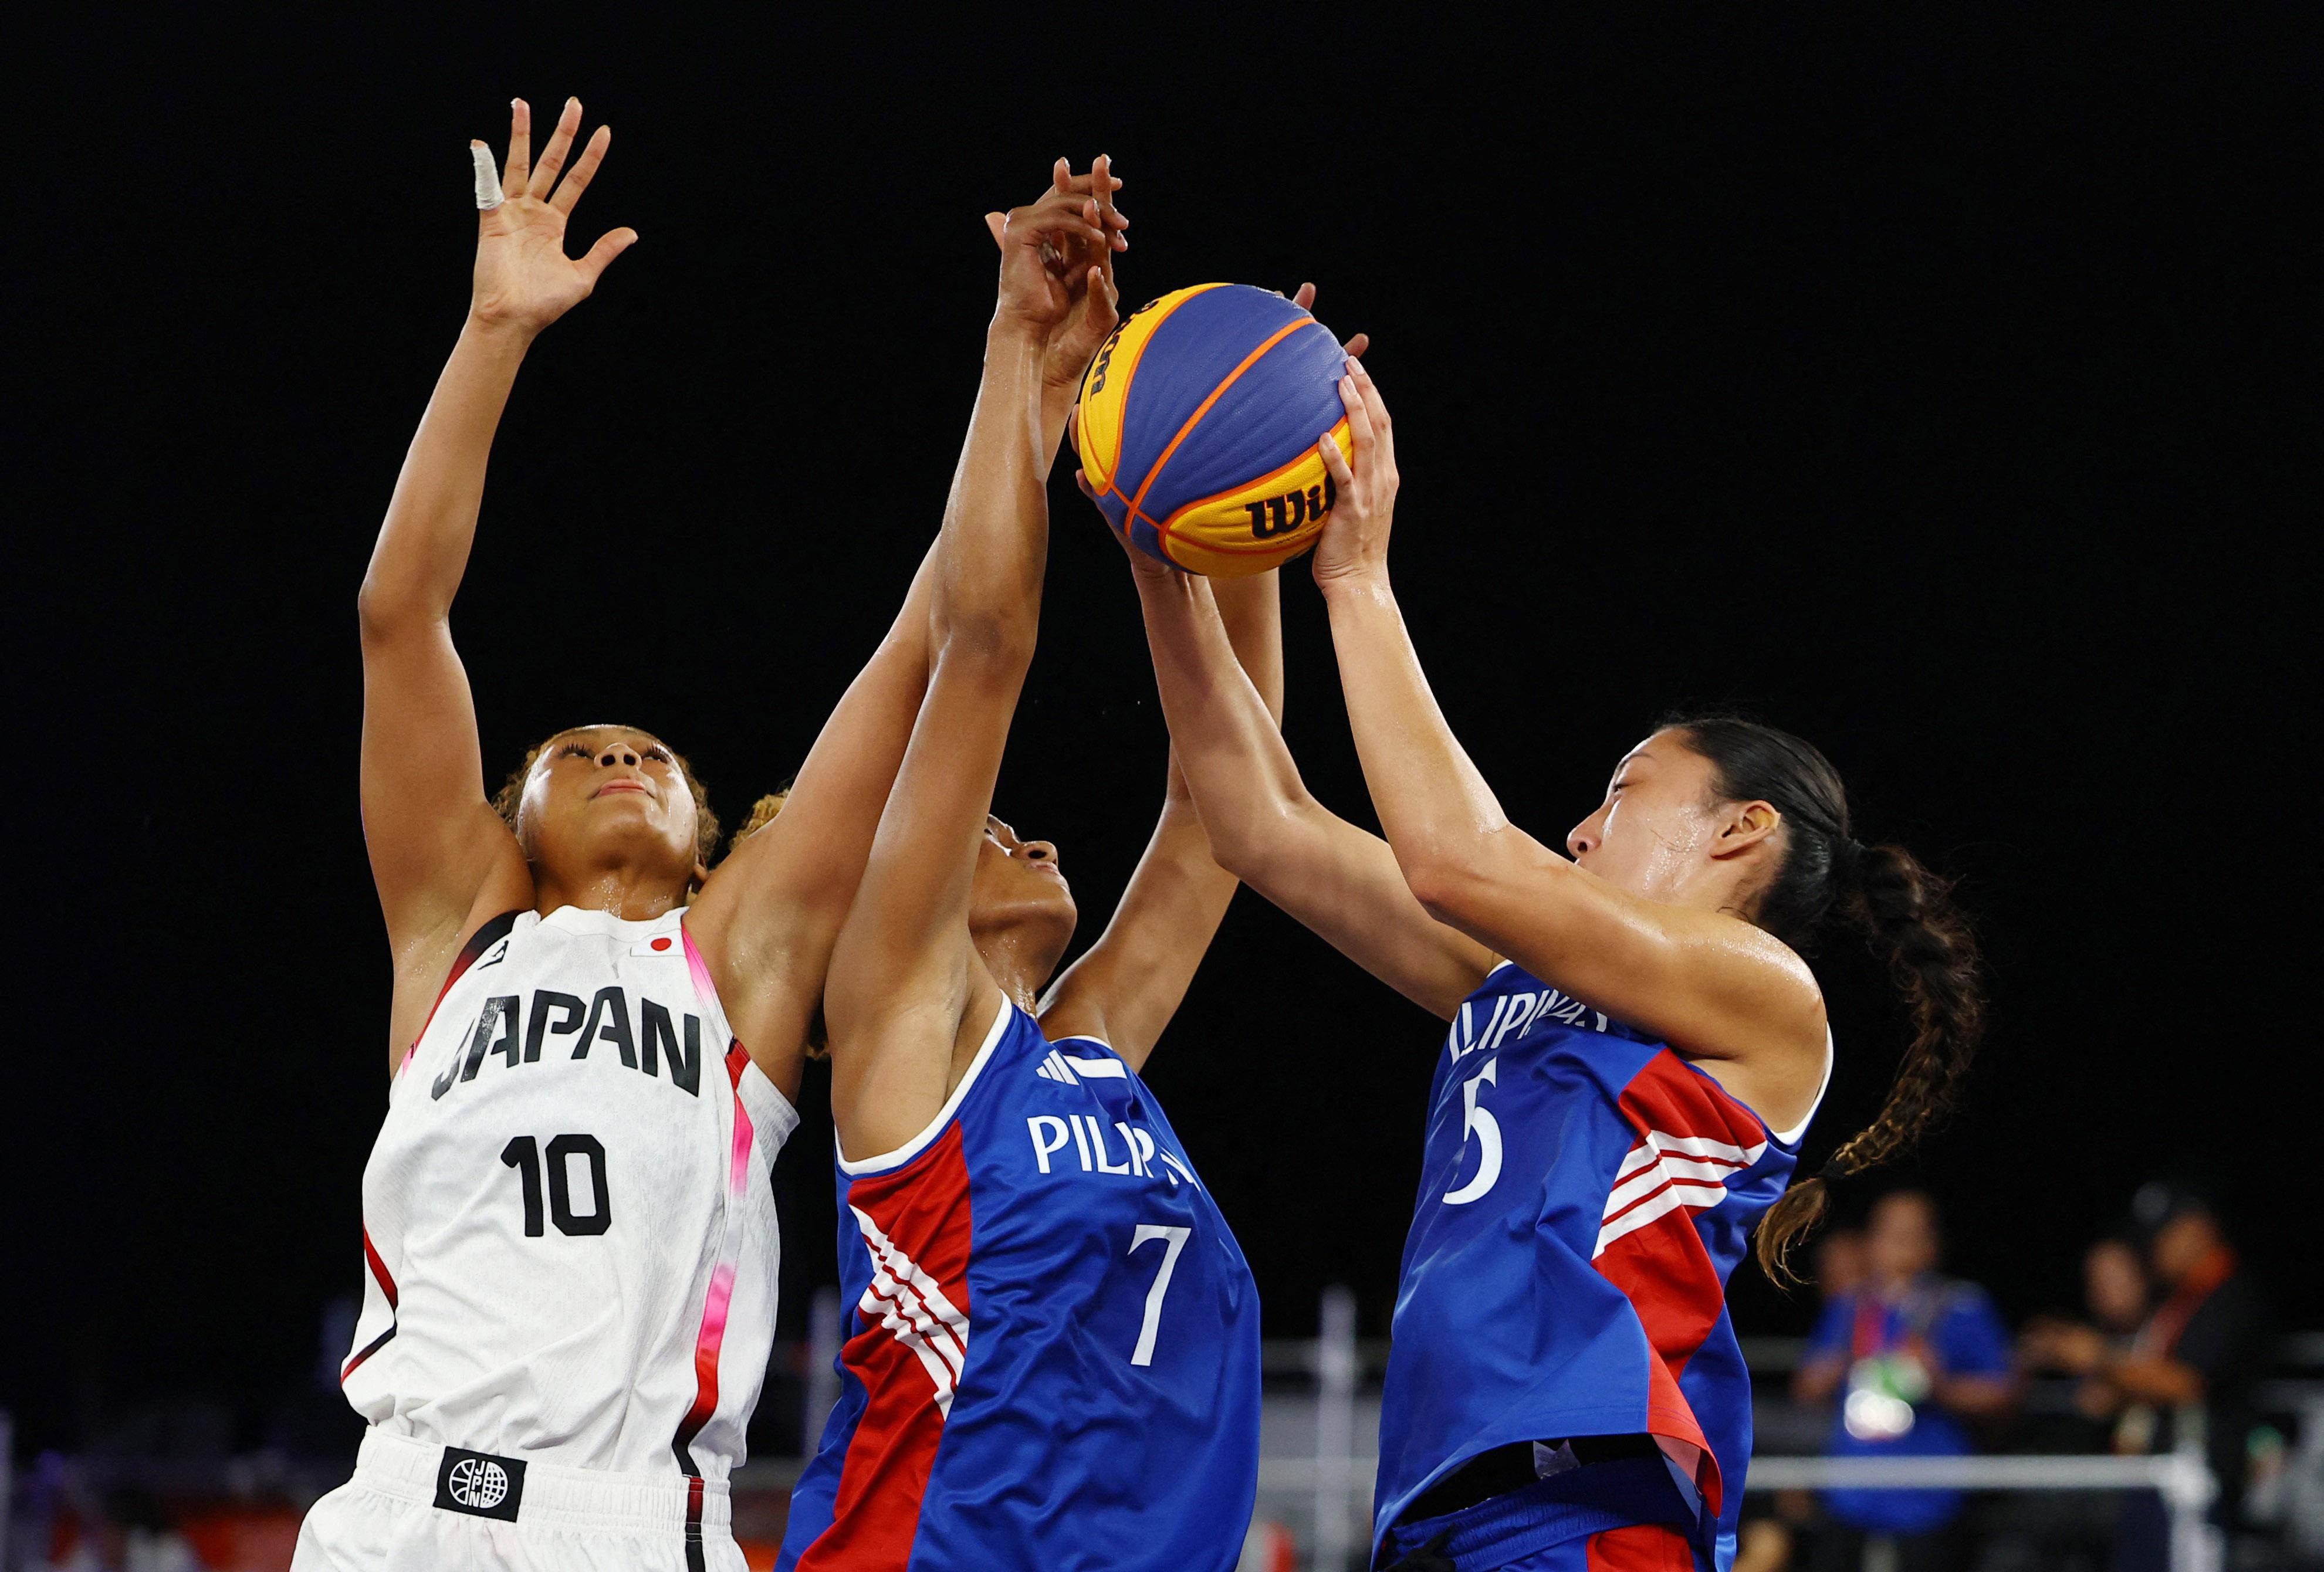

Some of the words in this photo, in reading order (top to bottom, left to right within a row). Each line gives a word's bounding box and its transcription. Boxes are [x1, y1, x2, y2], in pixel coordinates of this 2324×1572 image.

[431, 986, 701, 1101] JAPAN
[500, 1134, 611, 1237] 10
[1442, 1056, 1503, 1205] 5
[1128, 1224, 1192, 1367] 7
